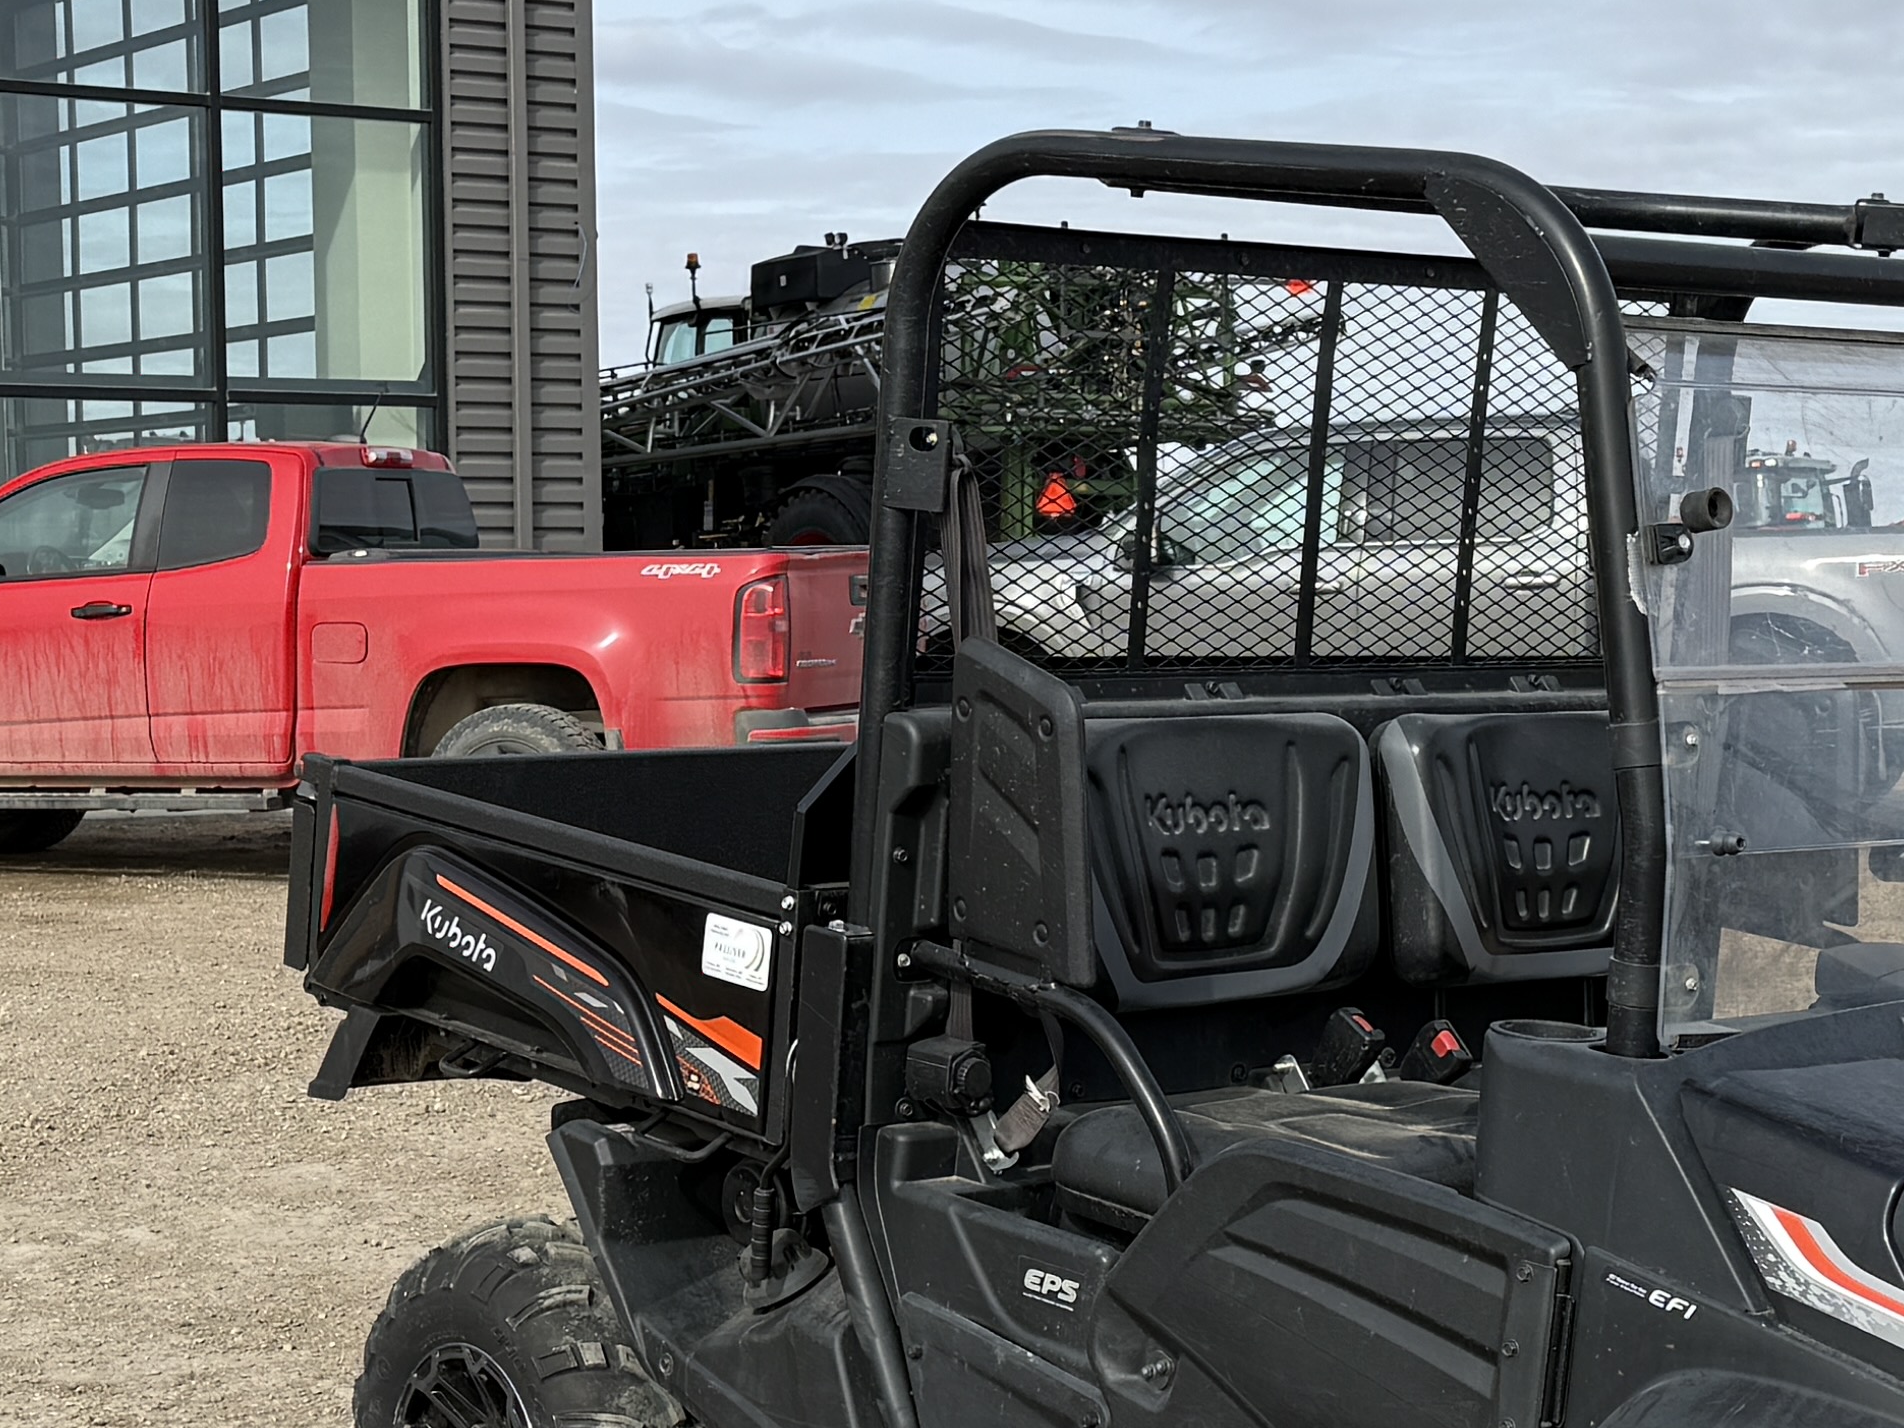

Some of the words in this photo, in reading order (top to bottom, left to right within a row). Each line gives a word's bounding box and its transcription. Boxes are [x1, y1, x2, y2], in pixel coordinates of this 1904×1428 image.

[1143, 792, 1270, 835] Kubota
[1489, 781, 1601, 822] Kubota
[420, 898, 497, 972] Kubota
[1023, 1268, 1080, 1303] EPS
[1648, 1289, 1698, 1320] EFI
